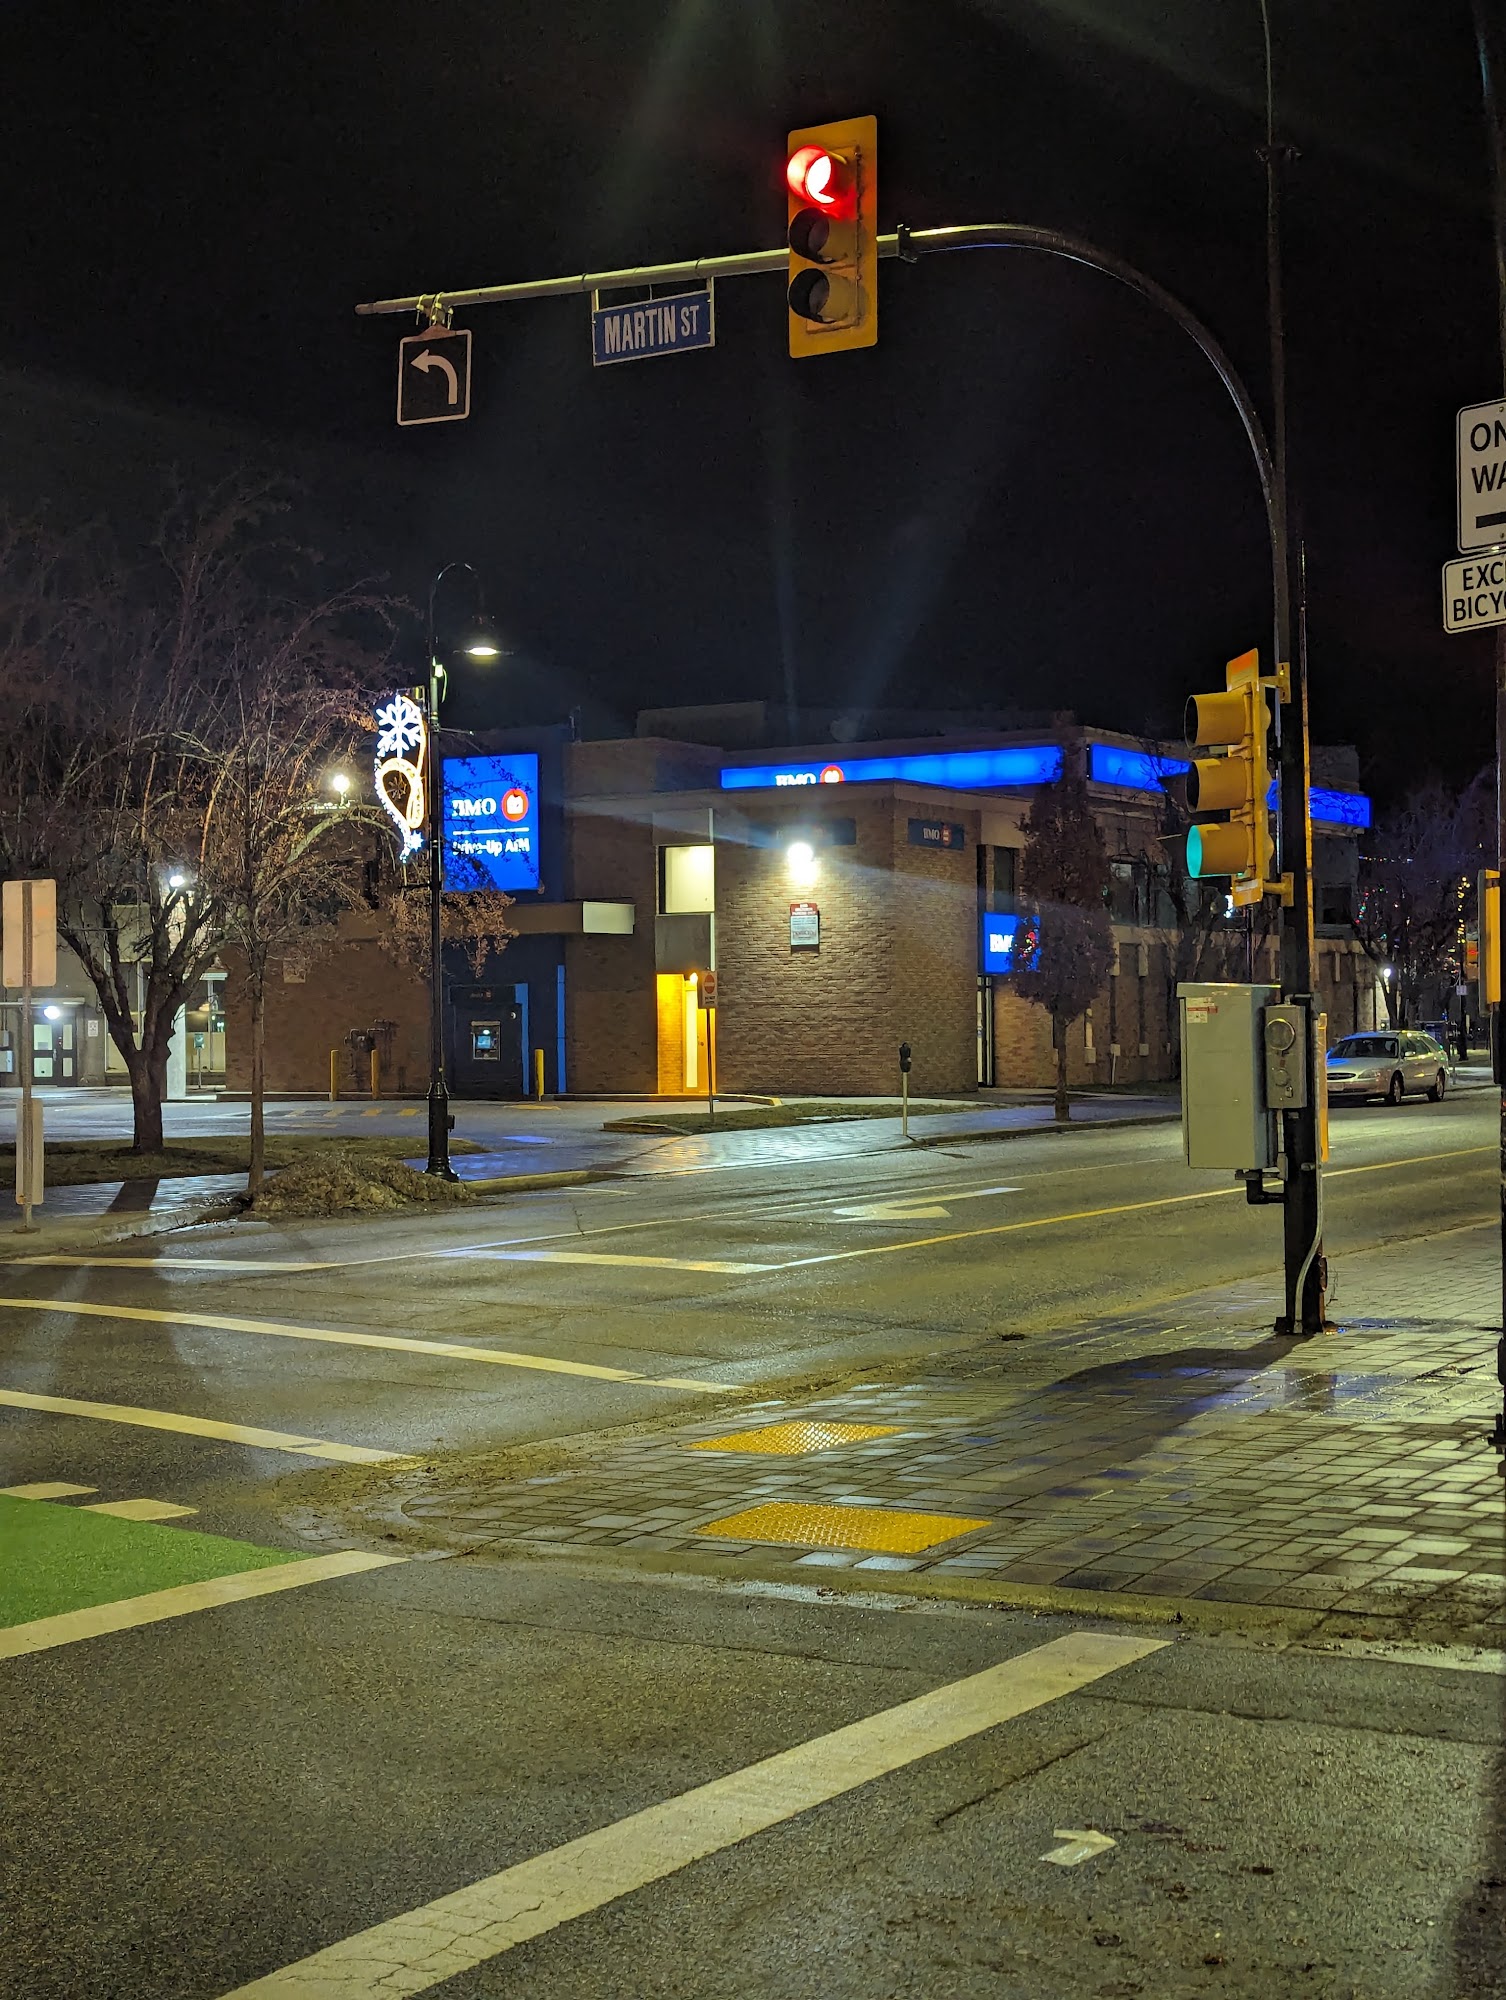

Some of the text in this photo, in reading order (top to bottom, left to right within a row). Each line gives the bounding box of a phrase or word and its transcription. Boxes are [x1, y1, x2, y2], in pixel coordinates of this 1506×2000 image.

[604, 304, 700, 354] MARTIN ST
[1463, 561, 1506, 591] EXC
[1453, 590, 1506, 622] BICY
[989, 933, 1014, 953] BM
